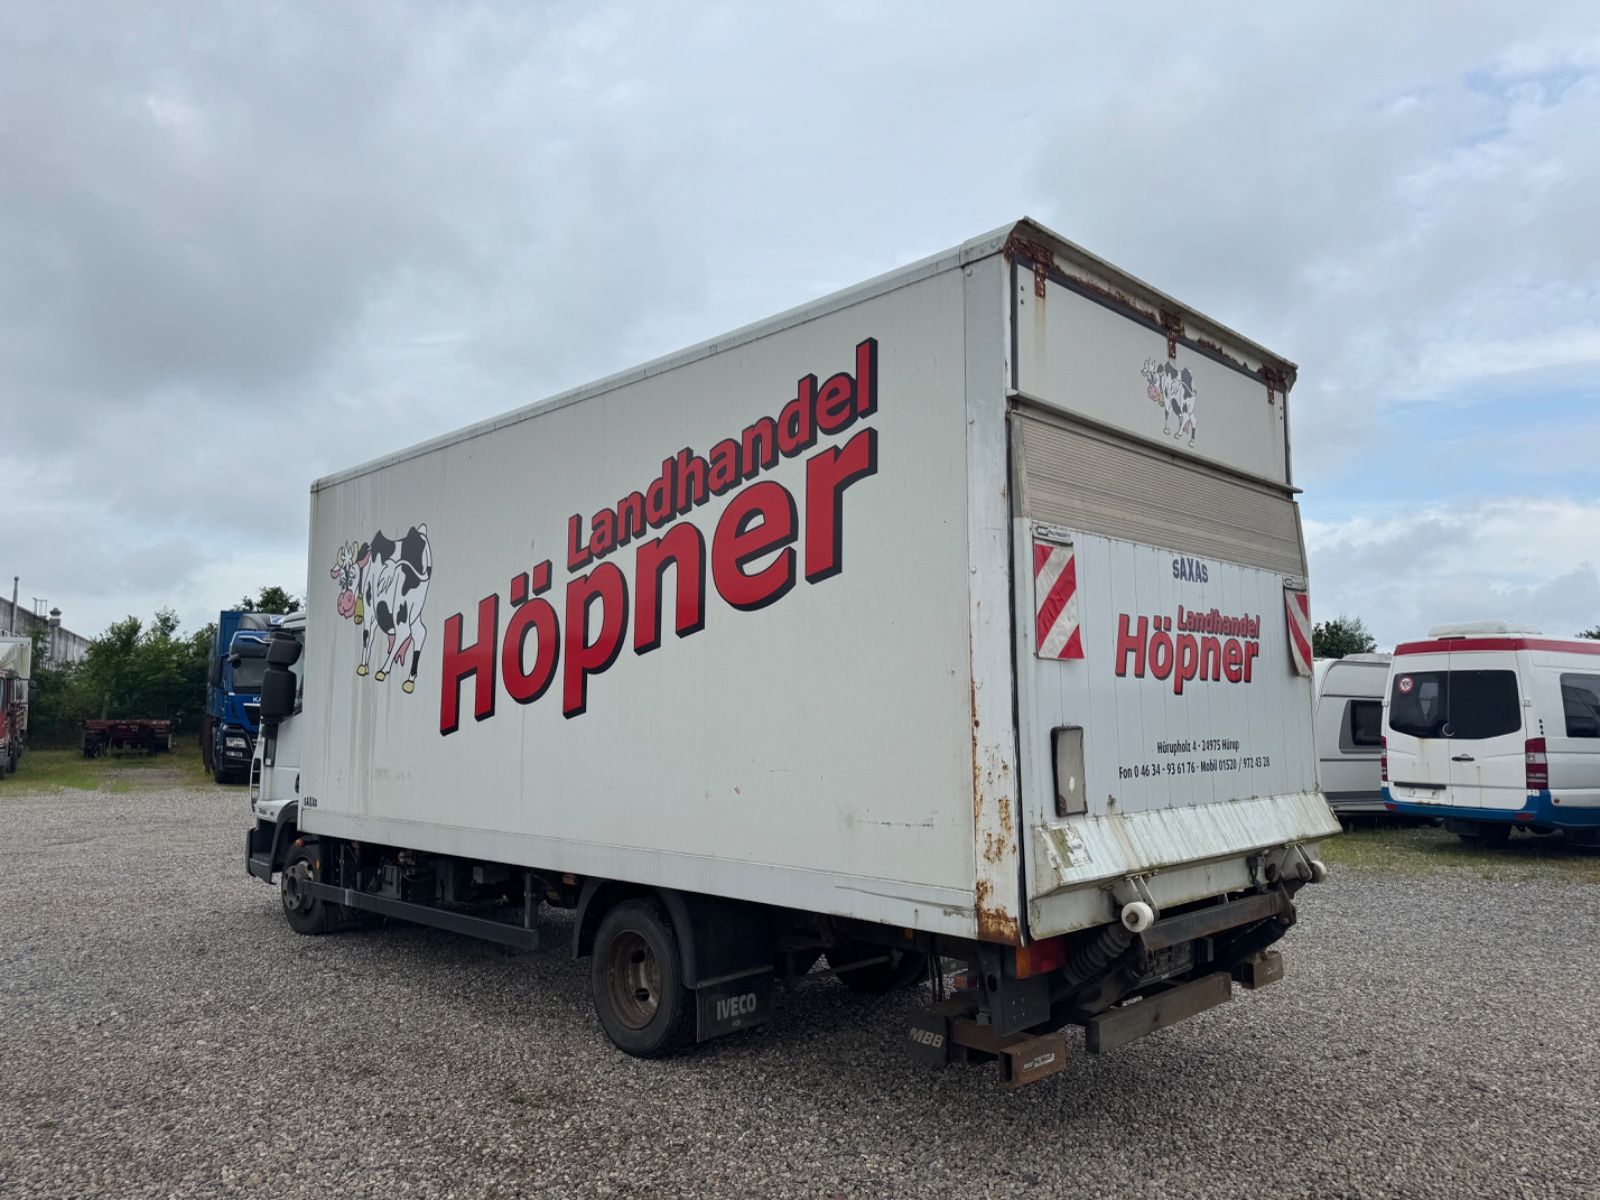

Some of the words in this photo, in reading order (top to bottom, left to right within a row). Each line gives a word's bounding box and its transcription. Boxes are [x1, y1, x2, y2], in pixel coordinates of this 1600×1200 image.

[567, 337, 878, 572] Landhandel
[440, 427, 878, 736] Höpner
[1172, 557, 1209, 583] SAXAS
[1177, 604, 1260, 639] Landhandel
[1115, 613, 1259, 695] Höpner
[1202, 740, 1221, 751] 24975
[1119, 766, 1132, 779] Fon
[1134, 765, 1139, 778] 0
[1141, 764, 1150, 777] 46
[1151, 763, 1161, 776] 34
[1166, 762, 1176, 775] 93
[1177, 762, 1185, 774] 61
[1187, 761, 1195, 774] 76
[1201, 759, 1217, 772] Mobil
[1219, 758, 1237, 771] 01520
[716, 992, 757, 1020] IVECO
[910, 1027, 944, 1048] MBB
